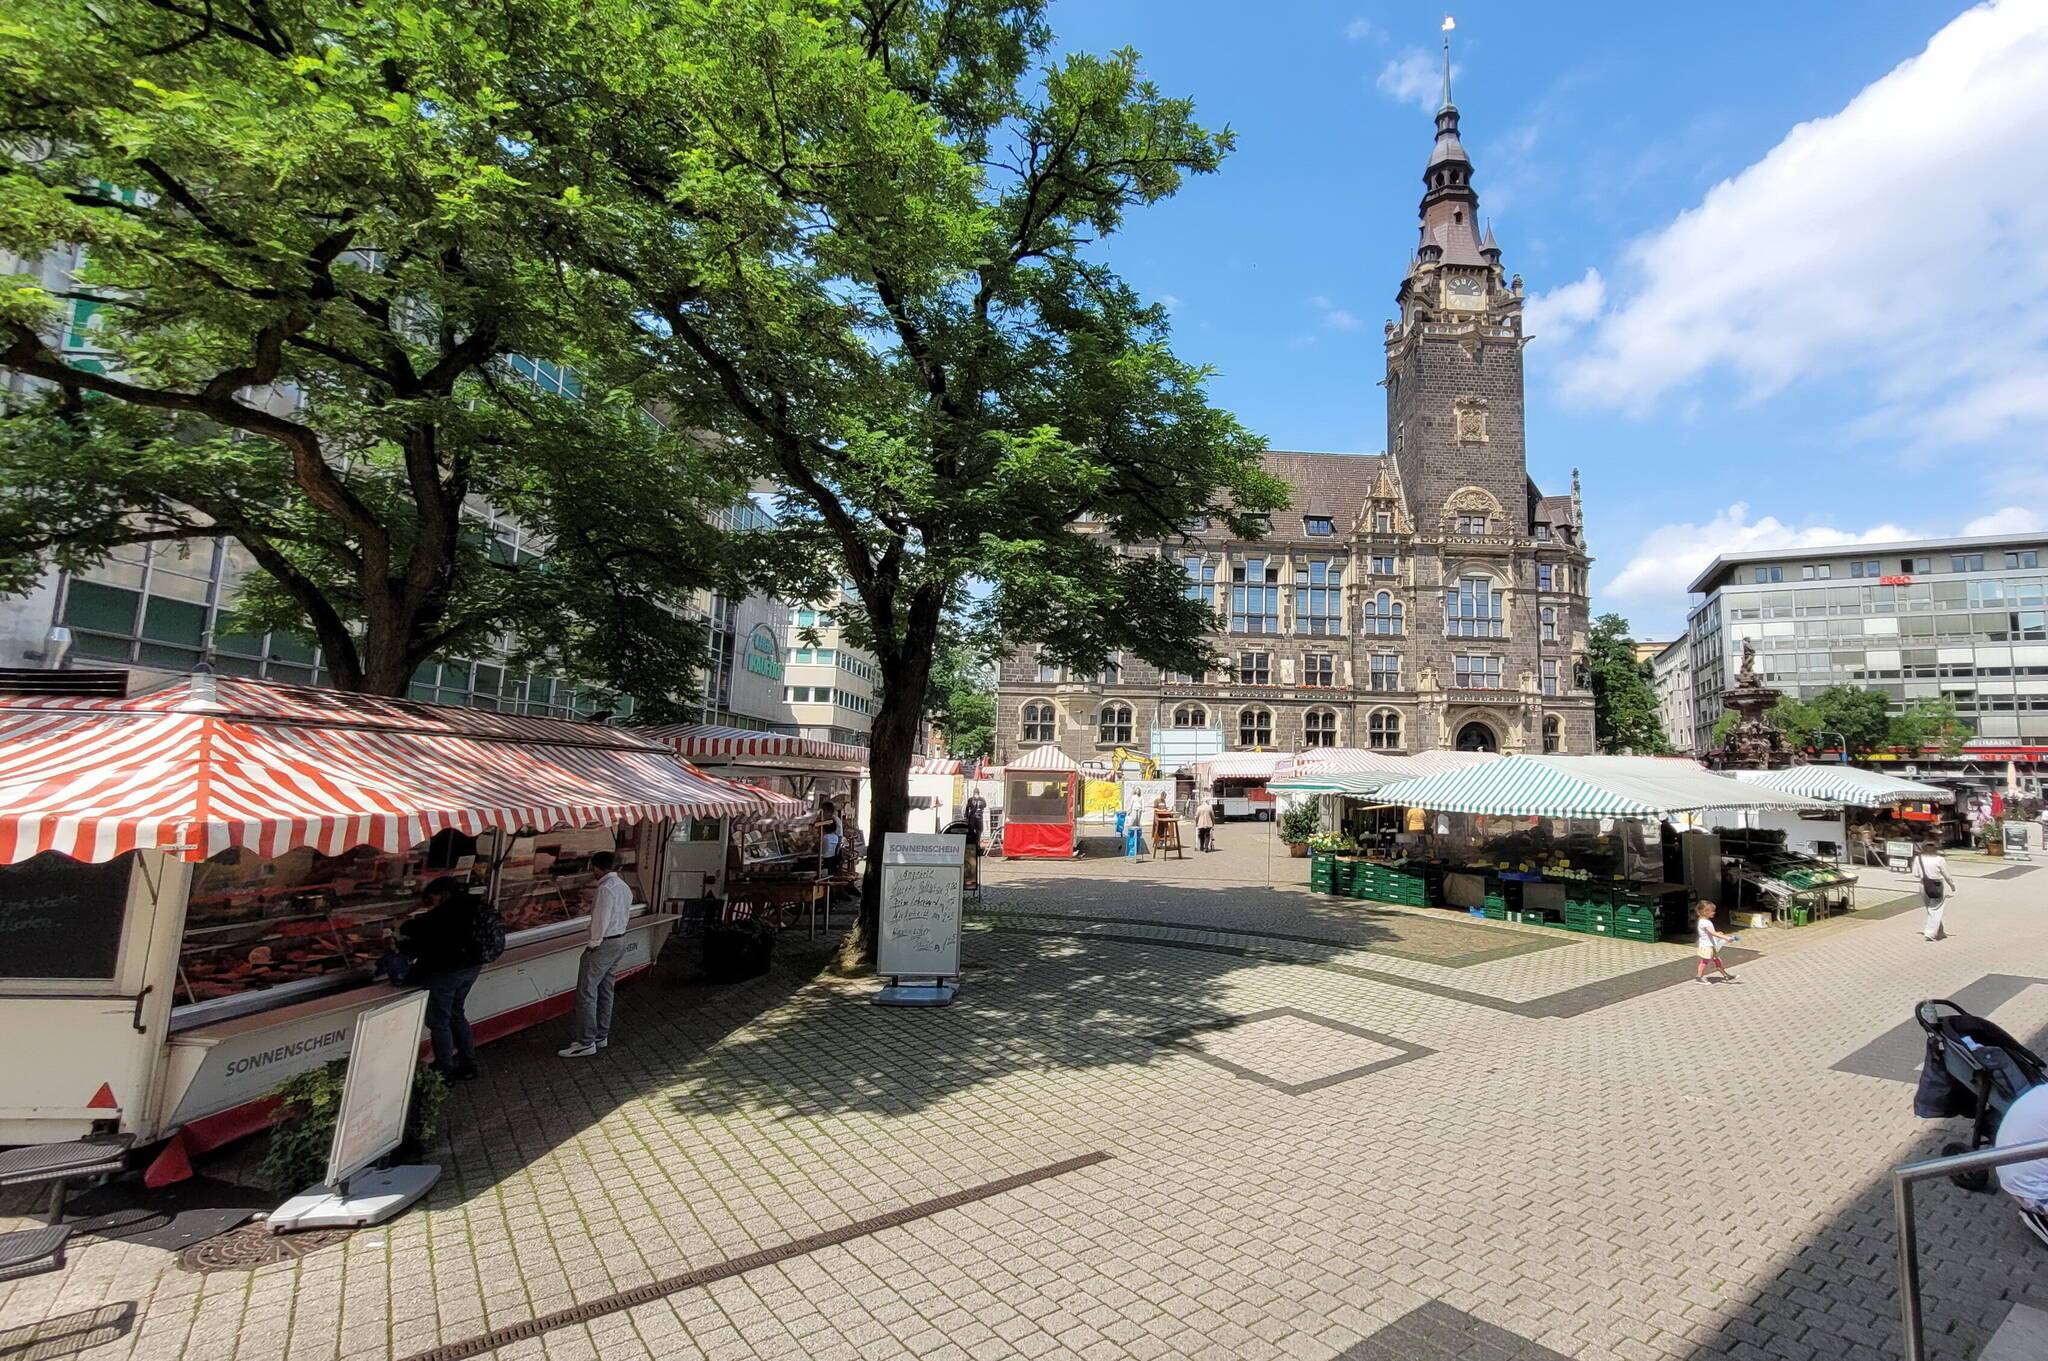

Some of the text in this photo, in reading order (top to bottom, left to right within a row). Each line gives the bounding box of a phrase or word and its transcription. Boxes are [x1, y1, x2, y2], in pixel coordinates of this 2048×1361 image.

[1880, 576, 1911, 586] ERGO
[889, 844, 960, 853] SONNENSCHEIN
[225, 1030, 347, 1077] SONNENSCHEIN
